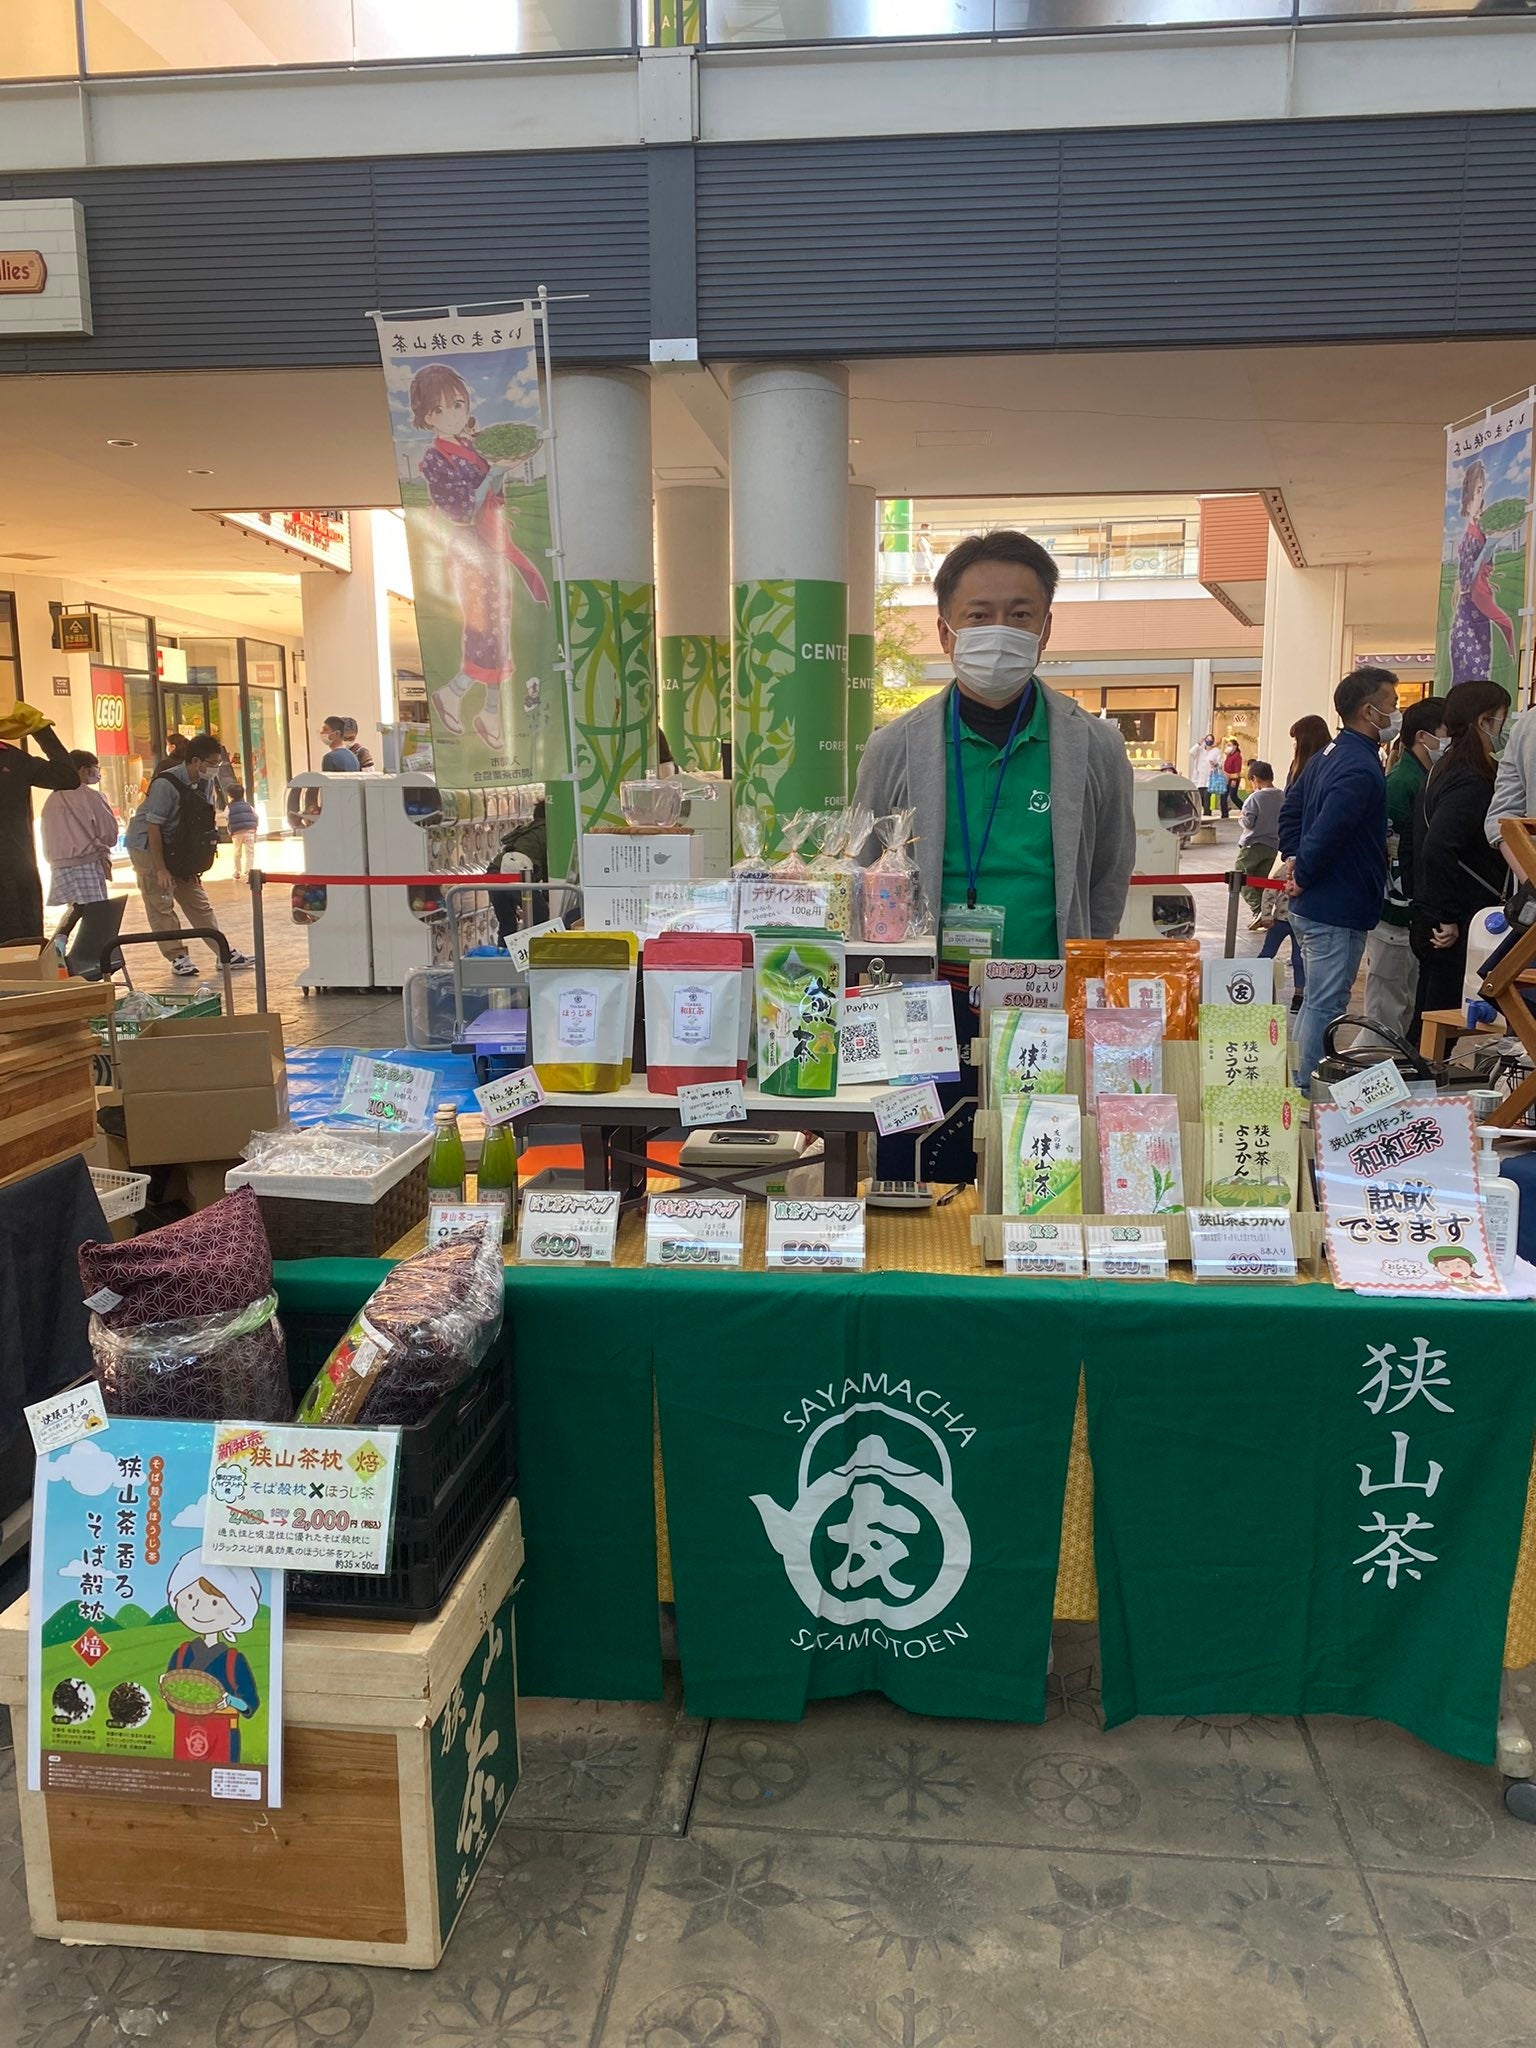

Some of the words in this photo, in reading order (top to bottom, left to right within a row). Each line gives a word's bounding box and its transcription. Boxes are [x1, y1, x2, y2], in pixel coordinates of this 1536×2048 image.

[0, 259, 30, 280] lies
[96, 696, 123, 728] LEGO
[752, 887, 818, 903] デザイン茶缶
[791, 906, 822, 916] 100g用
[986, 962, 1063, 979] 和紅茶リーフ
[1235, 985, 1249, 1000] 友
[562, 1010, 593, 1018] ほうじ茶
[680, 1007, 704, 1016] 和紅茶
[846, 1002, 879, 1014] PayPay
[1225, 1042, 1242, 1086] ようか
[1242, 1040, 1259, 1081] 狭山茶
[1329, 1109, 1413, 1152] 狭山茶で作った
[1235, 1125, 1252, 1177] ようかん
[1253, 1124, 1271, 1166] 狭山茶
[1350, 1118, 1443, 1177] 和紅茶
[1029, 1133, 1057, 1199] 狭山茶
[529, 1195, 614, 1215] ほうじ茶ティーバッグ
[1365, 1179, 1438, 1215] 試飲
[440, 1212, 489, 1222] 狭山茶コーラ
[654, 1200, 740, 1219] 和紅茶ティーバッグ
[774, 1201, 860, 1221] 煎茶ティーバッグ
[1198, 1214, 1285, 1227] 狭山茶ようかん
[1029, 1224, 1058, 1239] 煎茶
[1112, 1226, 1142, 1241] 煎茶
[1337, 1211, 1473, 1244] できます
[531, 1232, 592, 1258] 400円
[659, 1238, 721, 1263] 500円
[781, 1240, 843, 1265] 500円
[1226, 1253, 1278, 1275] 400円
[783, 1373, 977, 1448] SAYAMACHA
[217, 1432, 264, 1462] 新発売
[250, 1447, 343, 1471] 狭山茶枕
[355, 1451, 380, 1473] 焙
[1352, 1337, 1455, 1590] 狭山茶
[115, 1456, 141, 1599] 狭山茶香る
[827, 1482, 921, 1600] 友
[79, 1511, 107, 1622] そば殻枕
[80, 1635, 102, 1657] 焙
